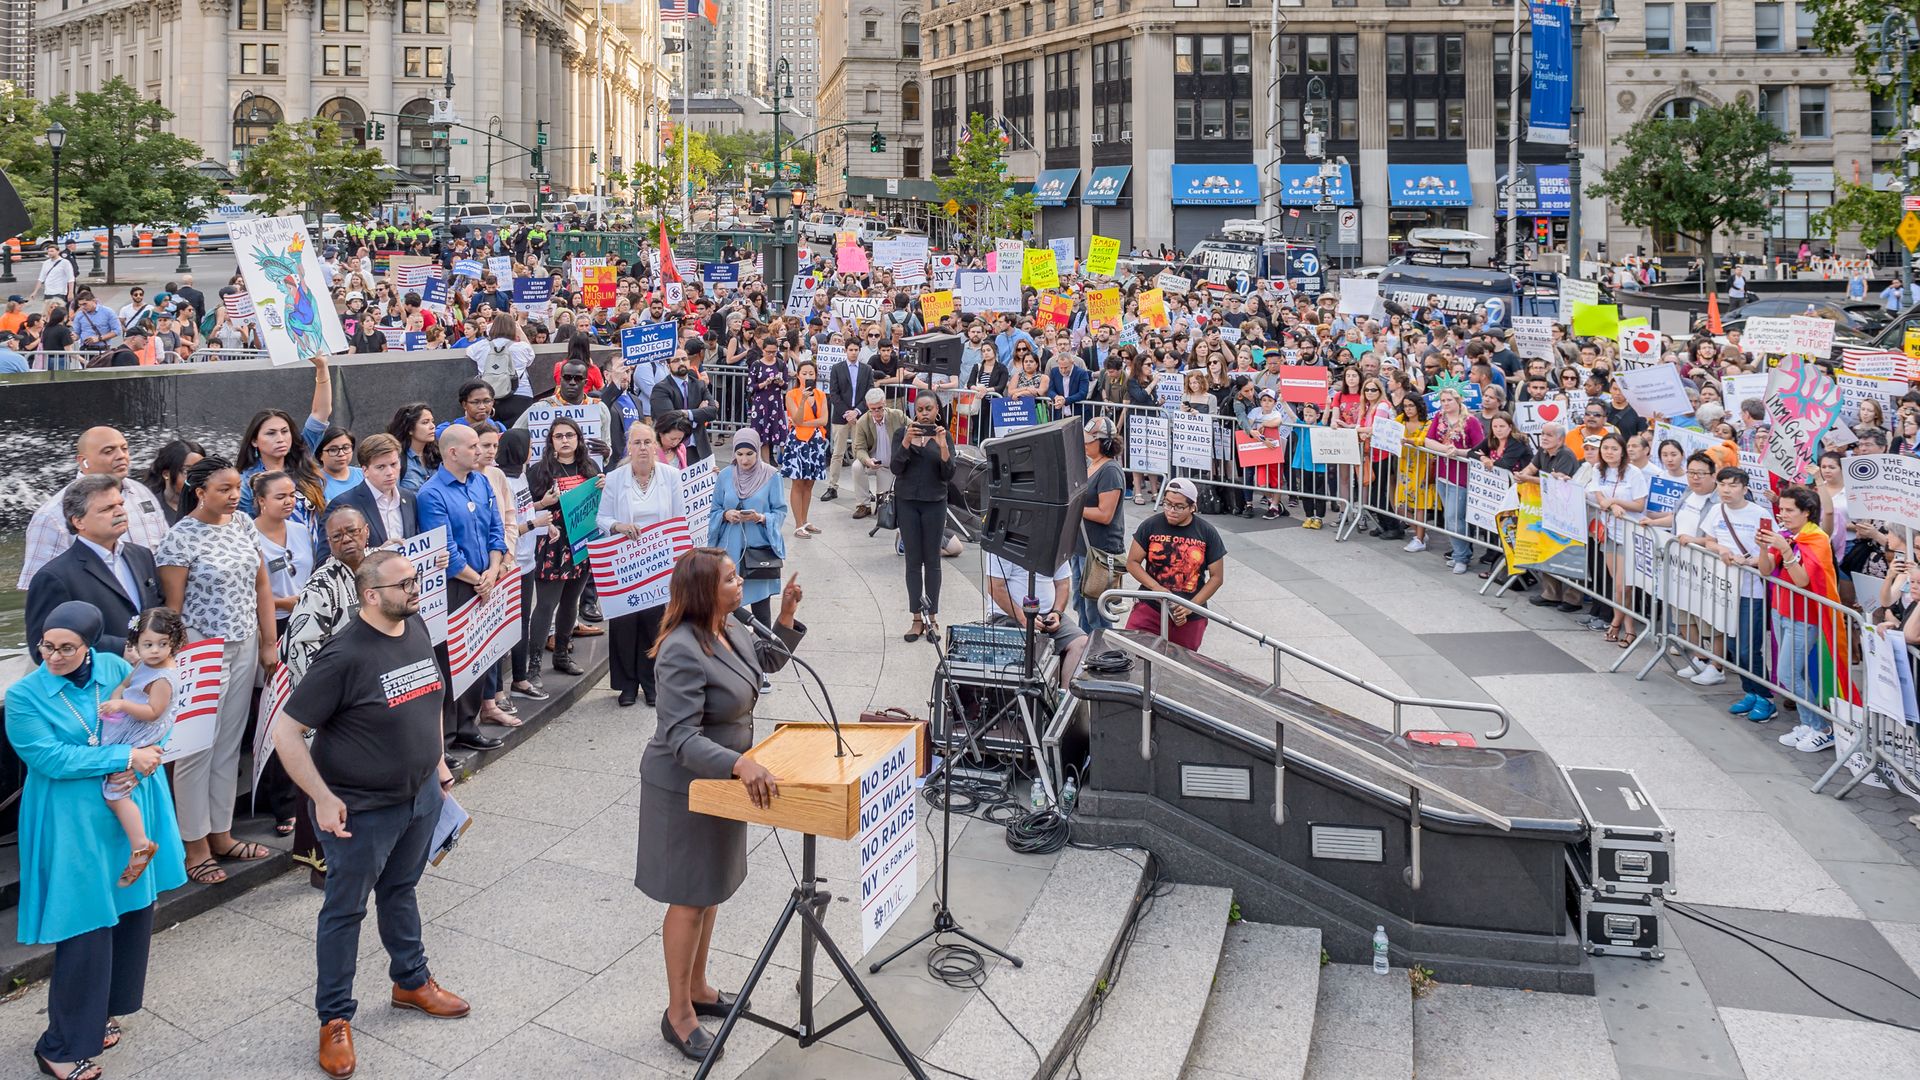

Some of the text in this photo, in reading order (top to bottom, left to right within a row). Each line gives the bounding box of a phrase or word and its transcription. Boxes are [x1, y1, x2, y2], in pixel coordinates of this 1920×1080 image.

[1535, 50, 1549, 60] Live
[1535, 60, 1550, 70] Your
[1535, 70, 1568, 82] Healthiest
[1538, 177, 1563, 186] SHOE
[1403, 188, 1460, 196] Corte Cafe
[230, 221, 252, 240] BAN
[276, 218, 293, 231] NOT
[999, 241, 1021, 250] SMASH
[1093, 238, 1118, 247] SMASH
[935, 256, 940, 267] I
[1030, 252, 1052, 264] SMASH
[1203, 250, 1251, 269] EYEWITNESS
[934, 271, 955, 282] NY
[584, 284, 599, 293] NO
[796, 277, 802, 290] I
[973, 275, 1009, 292] BAN
[1269, 281, 1272, 290] I
[584, 291, 615, 300] MUSLIM
[789, 295, 814, 308] NY
[922, 295, 936, 304] NO
[963, 295, 1021, 307] DONALD TRUMP
[1089, 293, 1103, 301] NO
[1140, 293, 1151, 301] NO
[584, 299, 600, 308] BAN
[923, 300, 952, 310] MUSLIM
[1089, 298, 1118, 309] MUSLIM
[1446, 296, 1477, 312] NEWS
[841, 302, 878, 319] LAND
[924, 310, 940, 318] BAN
[1038, 311, 1053, 321] NO
[641, 333, 659, 343] NYC
[629, 338, 671, 354] PROTECTS
[1624, 337, 1632, 352] I
[639, 350, 673, 363] neighbors
[1839, 377, 1878, 388] NO BAN
[1856, 390, 1885, 400] WALL
[529, 408, 585, 421] NO BAN
[1187, 414, 1204, 422] BAN
[1523, 404, 1535, 422] I
[1130, 427, 1165, 437] NO WALL
[1187, 425, 1209, 434] WALL
[1766, 394, 1816, 464] IMMIGRANT
[1130, 437, 1143, 445] NO
[1174, 433, 1211, 444] NO RAIDS
[1130, 447, 1142, 455] NY
[1768, 431, 1802, 482] JUSTICE
[1470, 459, 1482, 470] NO
[1881, 458, 1903, 466] THE
[690, 462, 709, 479] BAN
[691, 476, 716, 494] WALL
[1470, 472, 1505, 490] NO WALL
[1883, 474, 1920, 487] CIRCLE
[1469, 484, 1481, 494] NO
[1468, 496, 1479, 506] NY
[694, 518, 699, 526] IS
[620, 531, 660, 553] I PLEDGE
[1149, 534, 1207, 547] CODE ORANGE
[615, 538, 669, 565] TO PROTECT
[617, 548, 671, 576] IMMIGRANT
[621, 558, 670, 585] NEW YORK
[429, 598, 443, 611] ALL
[466, 593, 506, 634] TO PROTECT
[466, 603, 505, 645] IMMIGRANT
[468, 614, 504, 653] NEW YORK
[383, 674, 415, 691] STAND
[385, 682, 412, 700] WITH
[862, 747, 906, 800] NO BAN
[861, 774, 912, 833] NO WALL
[862, 802, 914, 867] NO RAIDS
[862, 838, 914, 901] NY IS FOR ALL
